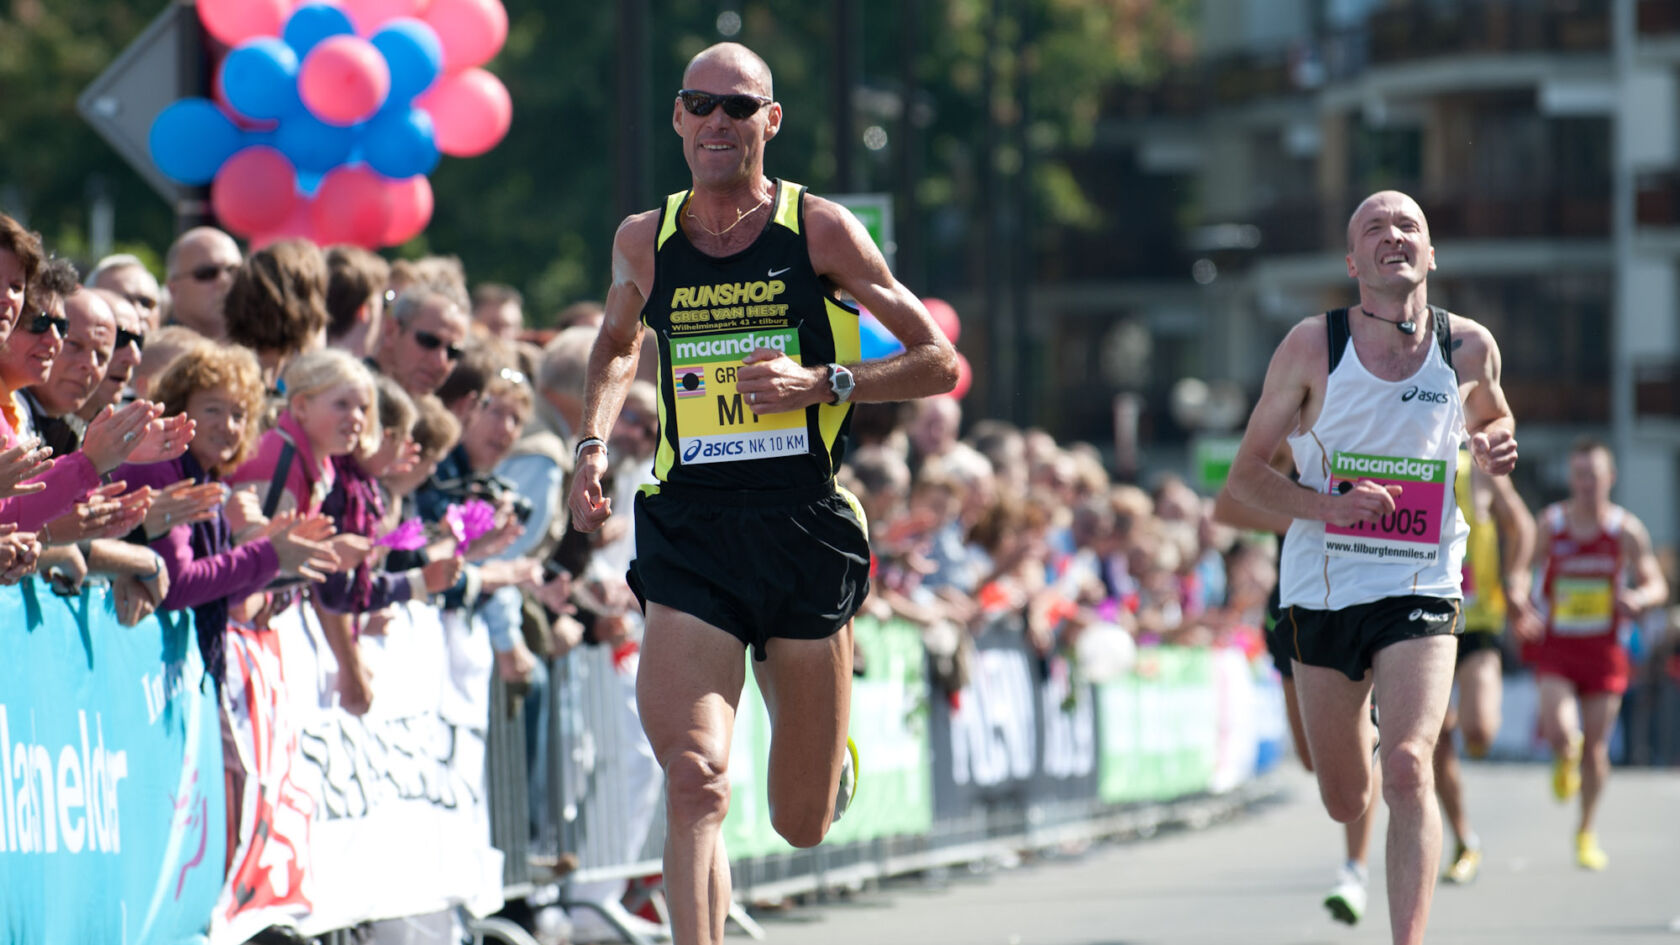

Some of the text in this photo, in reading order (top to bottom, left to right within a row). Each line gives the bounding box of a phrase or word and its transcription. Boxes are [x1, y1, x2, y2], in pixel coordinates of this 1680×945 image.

[671, 280, 786, 309] RUNSHOP
[669, 304, 789, 324] GREG VAN HEST
[671, 320, 737, 331] Wilhelminapark
[675, 333, 786, 359] maandag
[715, 366, 745, 384] GR
[1418, 390, 1448, 404] asics
[703, 434, 804, 457] asics NK 10 KM
[1337, 455, 1435, 482] maandag
[1350, 508, 1428, 536] 005
[1326, 541, 1437, 561] www.tilburgtenmiles.nl
